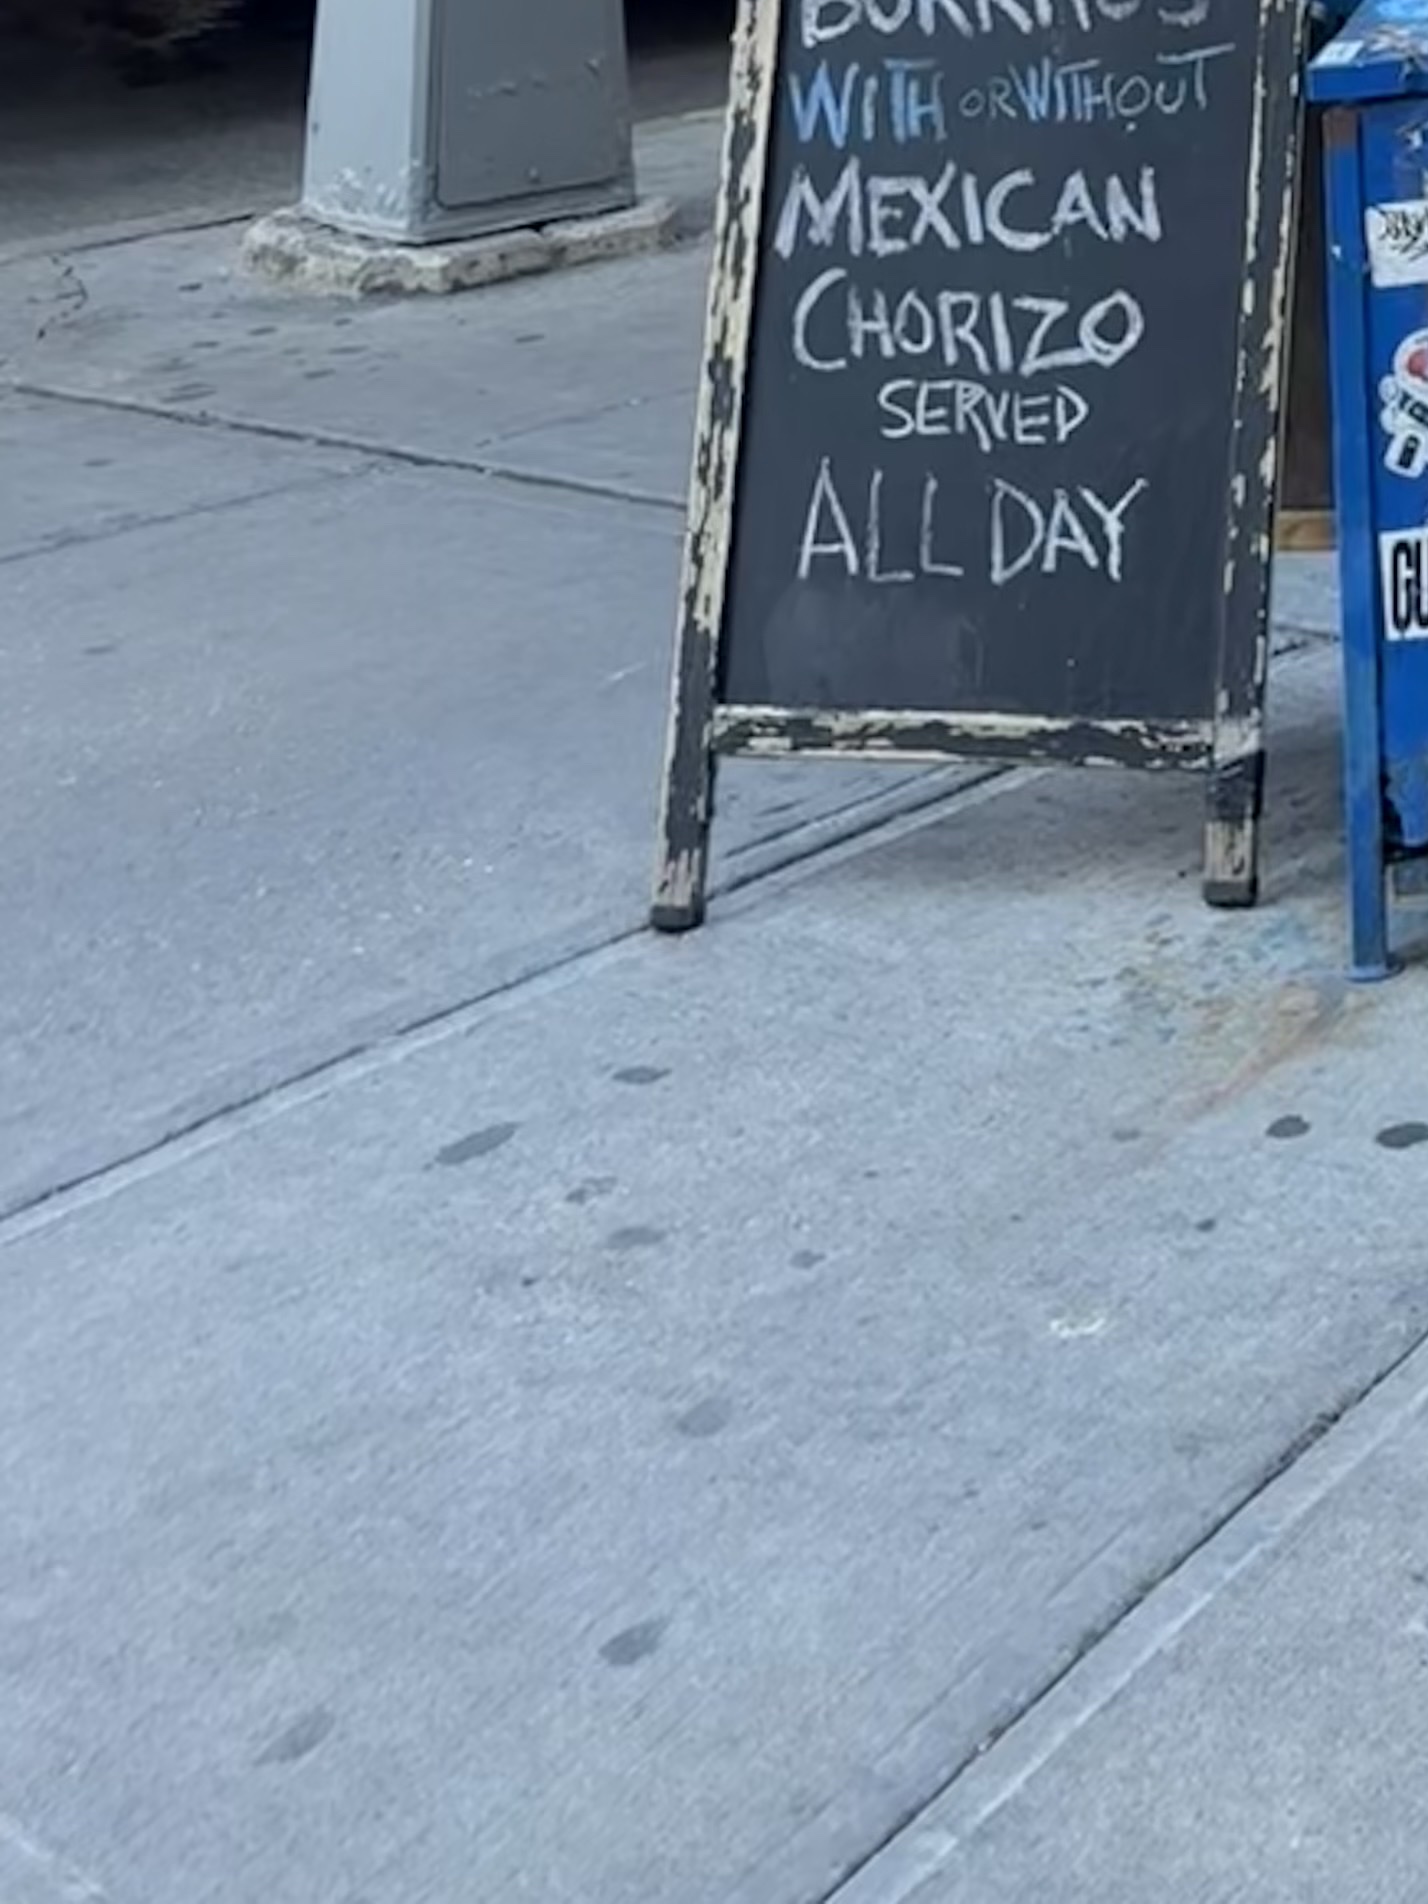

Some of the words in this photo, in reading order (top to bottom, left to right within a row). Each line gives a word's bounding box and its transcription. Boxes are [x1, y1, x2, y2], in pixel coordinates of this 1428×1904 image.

[788, 57, 948, 149] WITH
[1008, 42, 1236, 123] WITHOUT
[773, 155, 1162, 260] MEXICAN
[793, 267, 1145, 377] CHORIZO
[878, 378, 1089, 453] SERVED
[798, 455, 964, 583] ALL
[990, 477, 1150, 585] DAY
